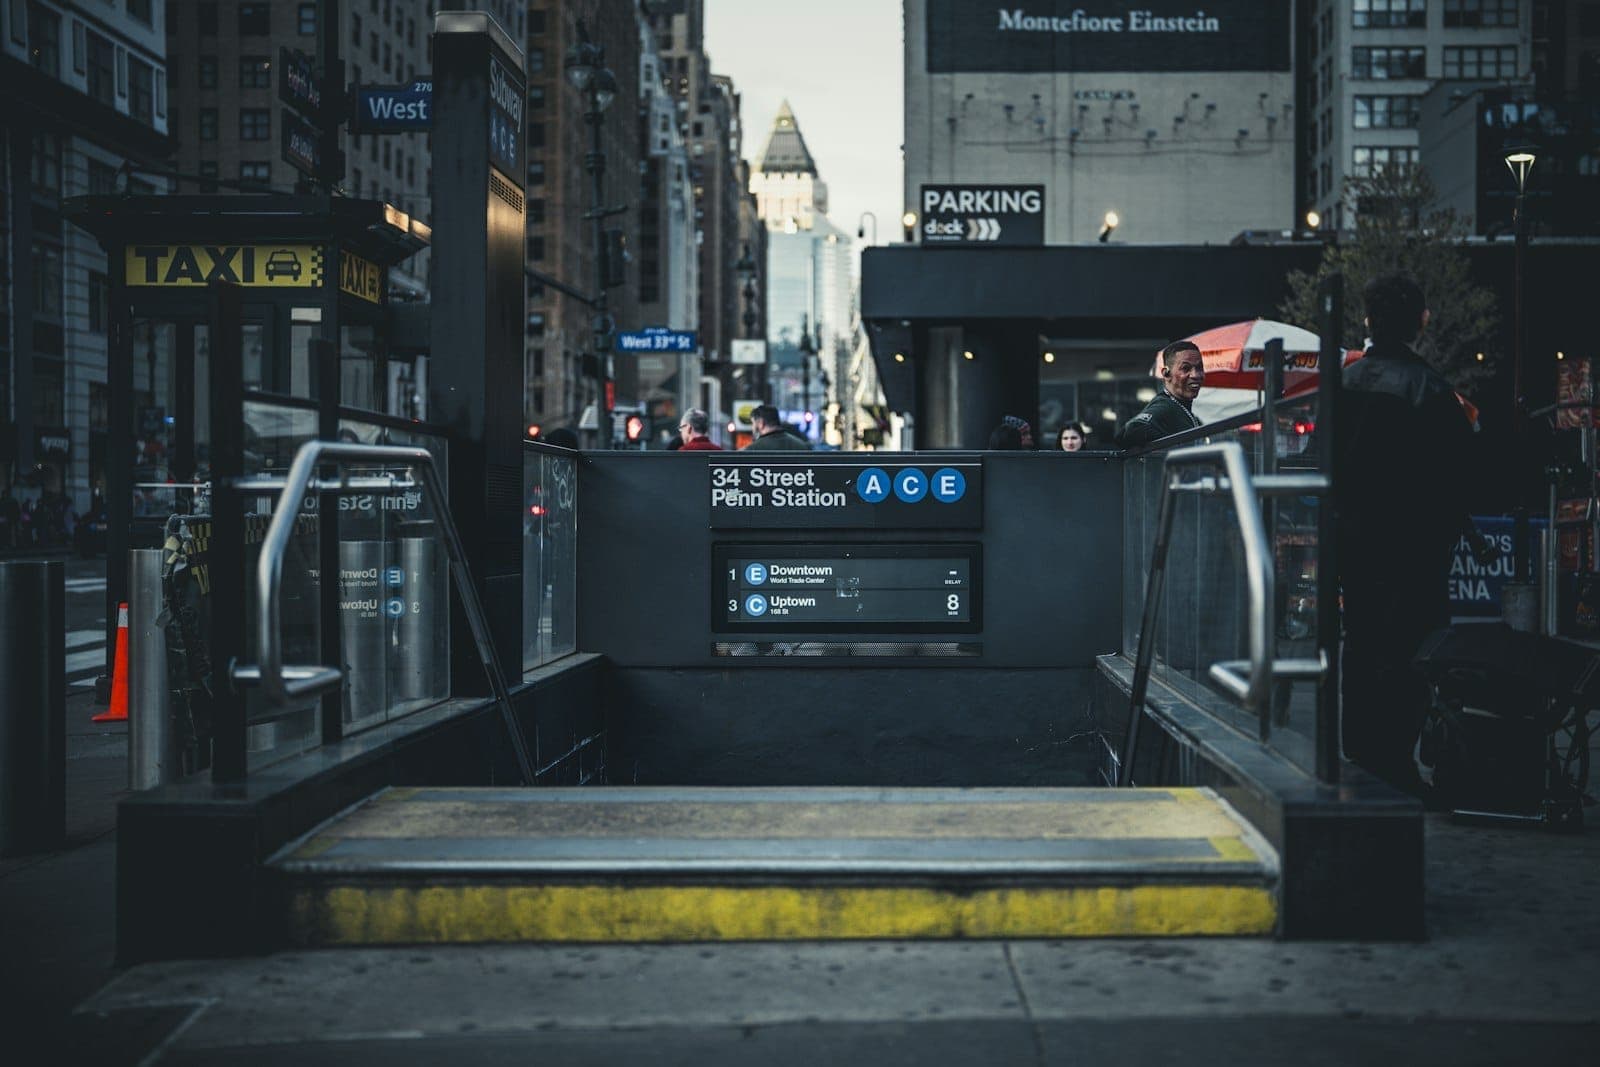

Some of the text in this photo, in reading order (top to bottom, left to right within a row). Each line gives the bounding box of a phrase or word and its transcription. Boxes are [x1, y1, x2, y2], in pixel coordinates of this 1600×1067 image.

[999, 9, 1220, 32] Montefiore Einstein
[490, 59, 522, 133] Subway
[368, 96, 428, 120] West
[923, 189, 1041, 213] PARKING
[135, 247, 255, 283] TAXI
[341, 250, 368, 297] TAXI
[622, 335, 652, 349] West
[712, 468, 815, 487] 34 Street
[865, 475, 956, 495] A C E
[711, 488, 846, 507] Penn Station
[729, 565, 833, 581] 1 E Downtown
[728, 596, 816, 612] 3 C Uptown
[947, 593, 959, 611] 8
